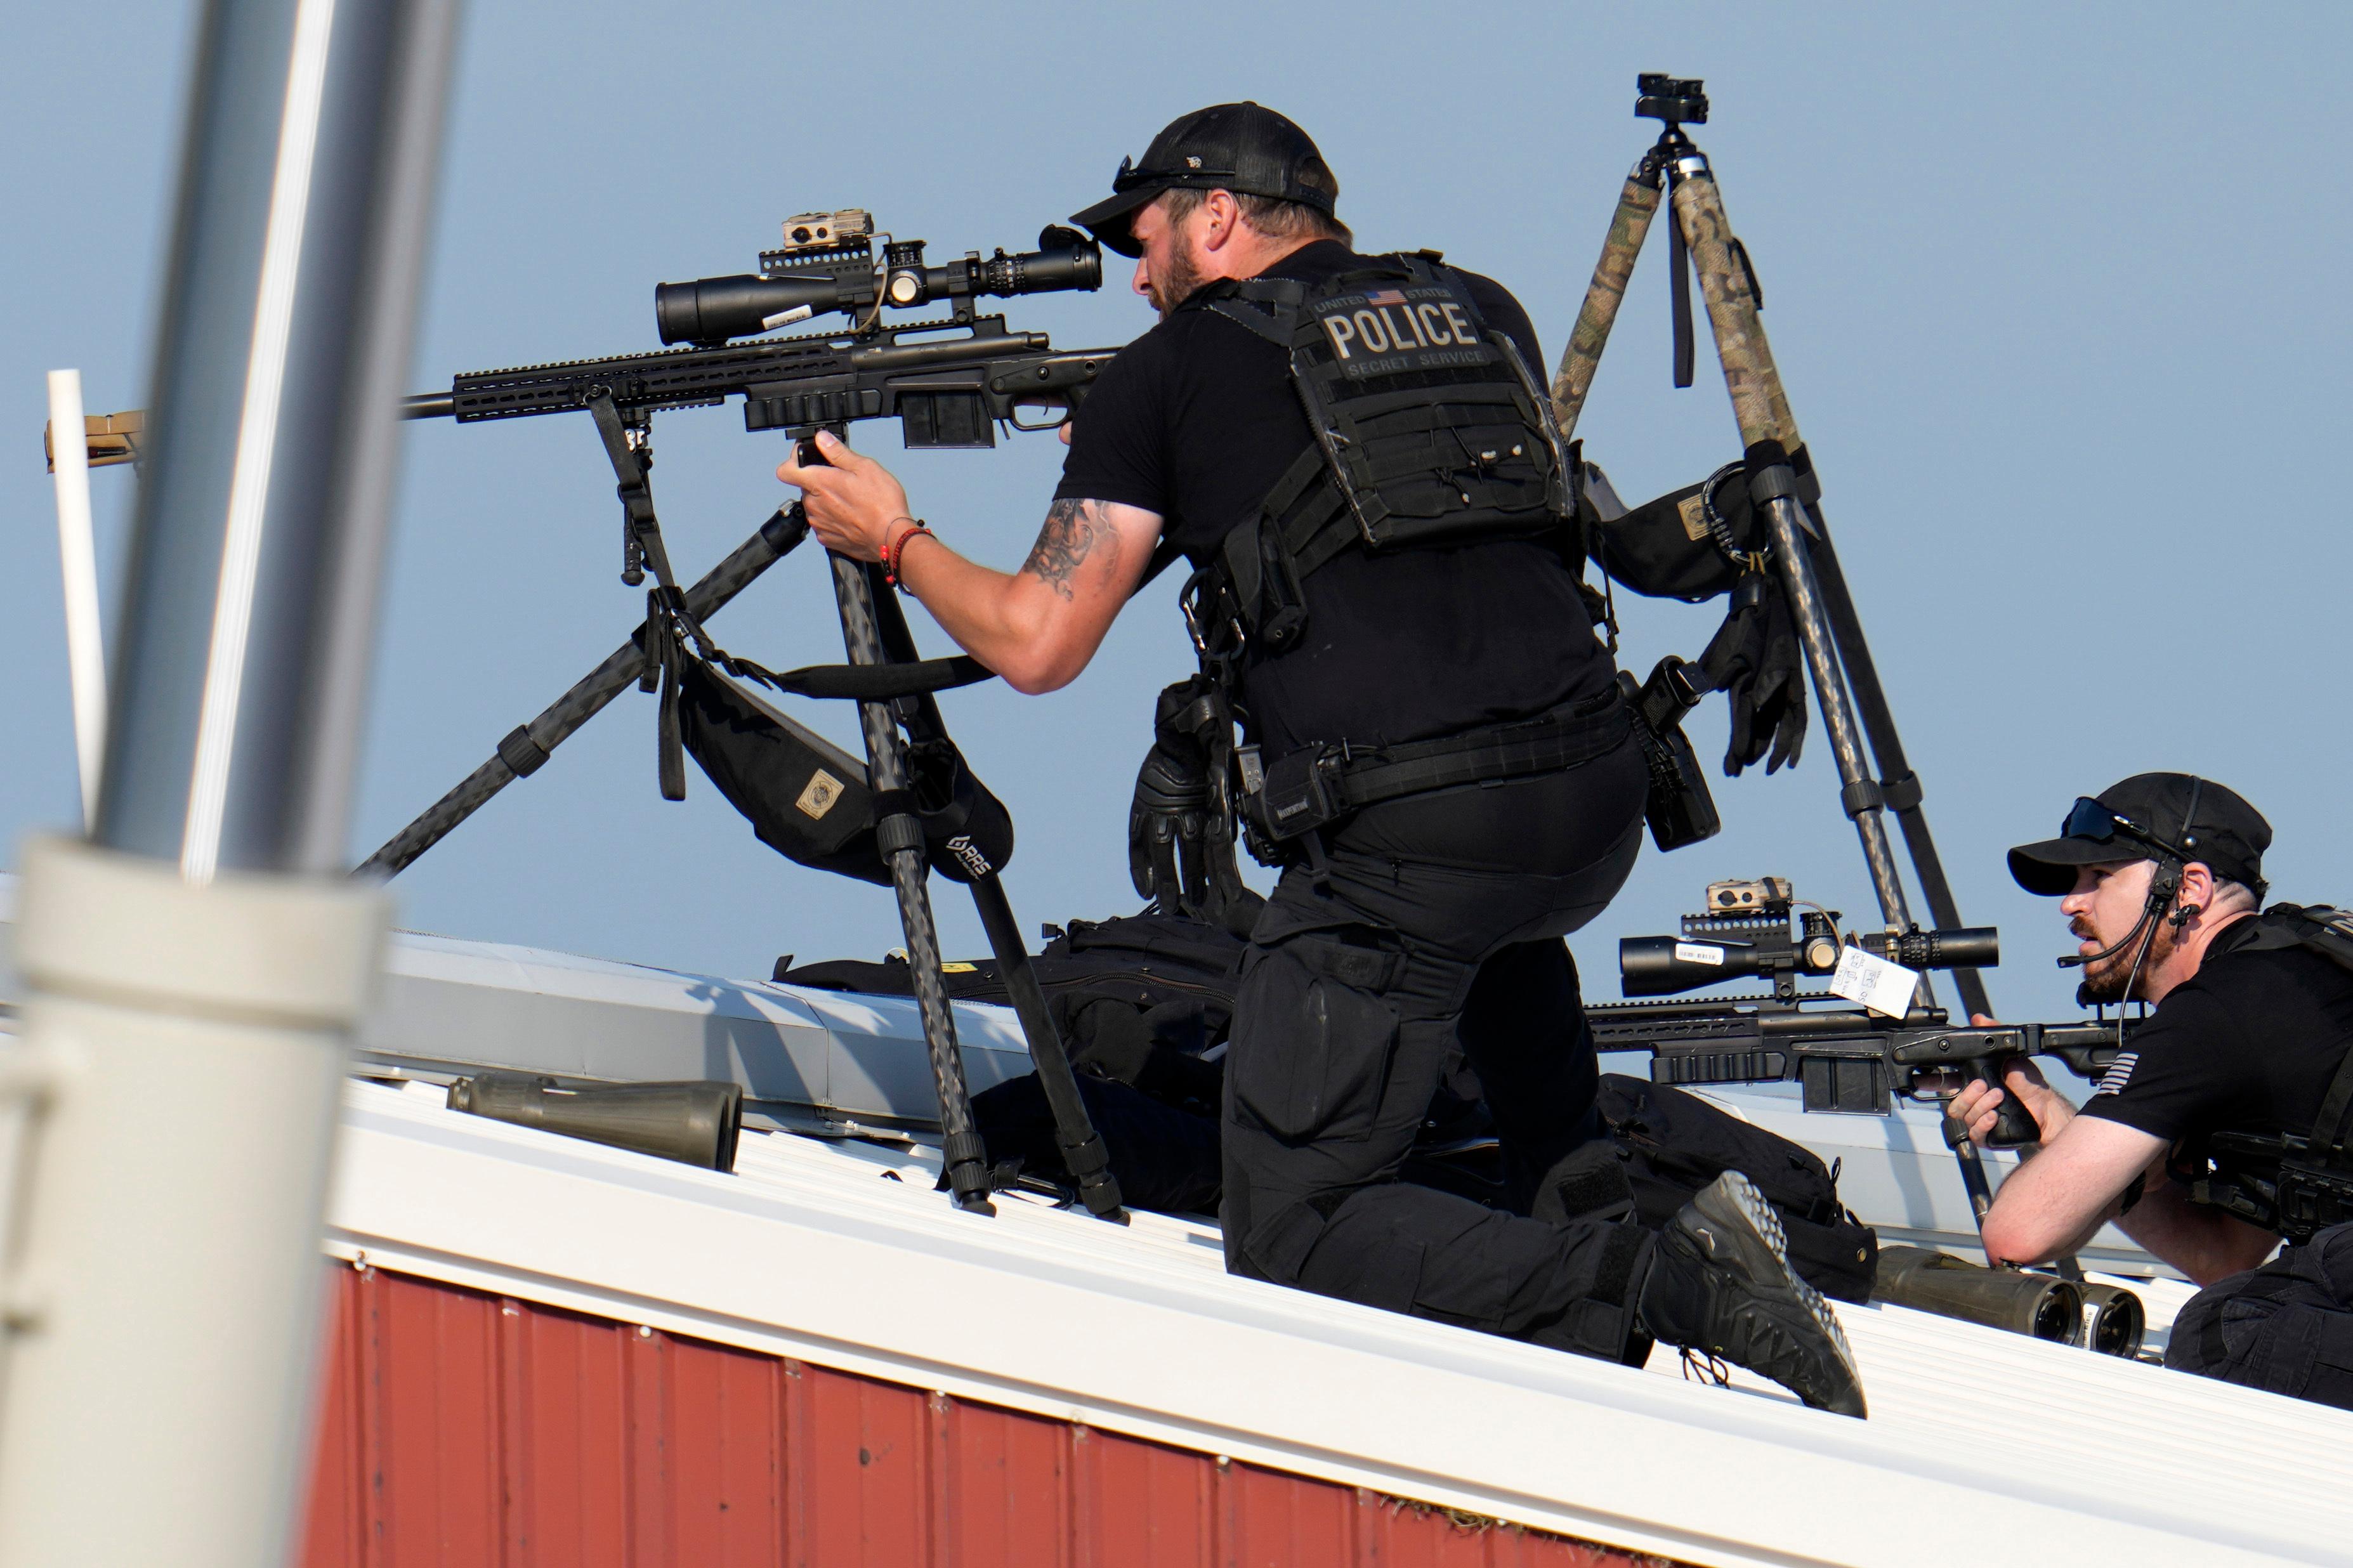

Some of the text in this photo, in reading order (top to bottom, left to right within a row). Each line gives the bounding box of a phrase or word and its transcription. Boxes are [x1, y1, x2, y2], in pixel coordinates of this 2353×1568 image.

[1314, 296, 1366, 313] UNITED
[1323, 303, 1478, 360] POLICE
[1348, 351, 1485, 377] SECRET SERVICE
[961, 845, 992, 875] RRS
